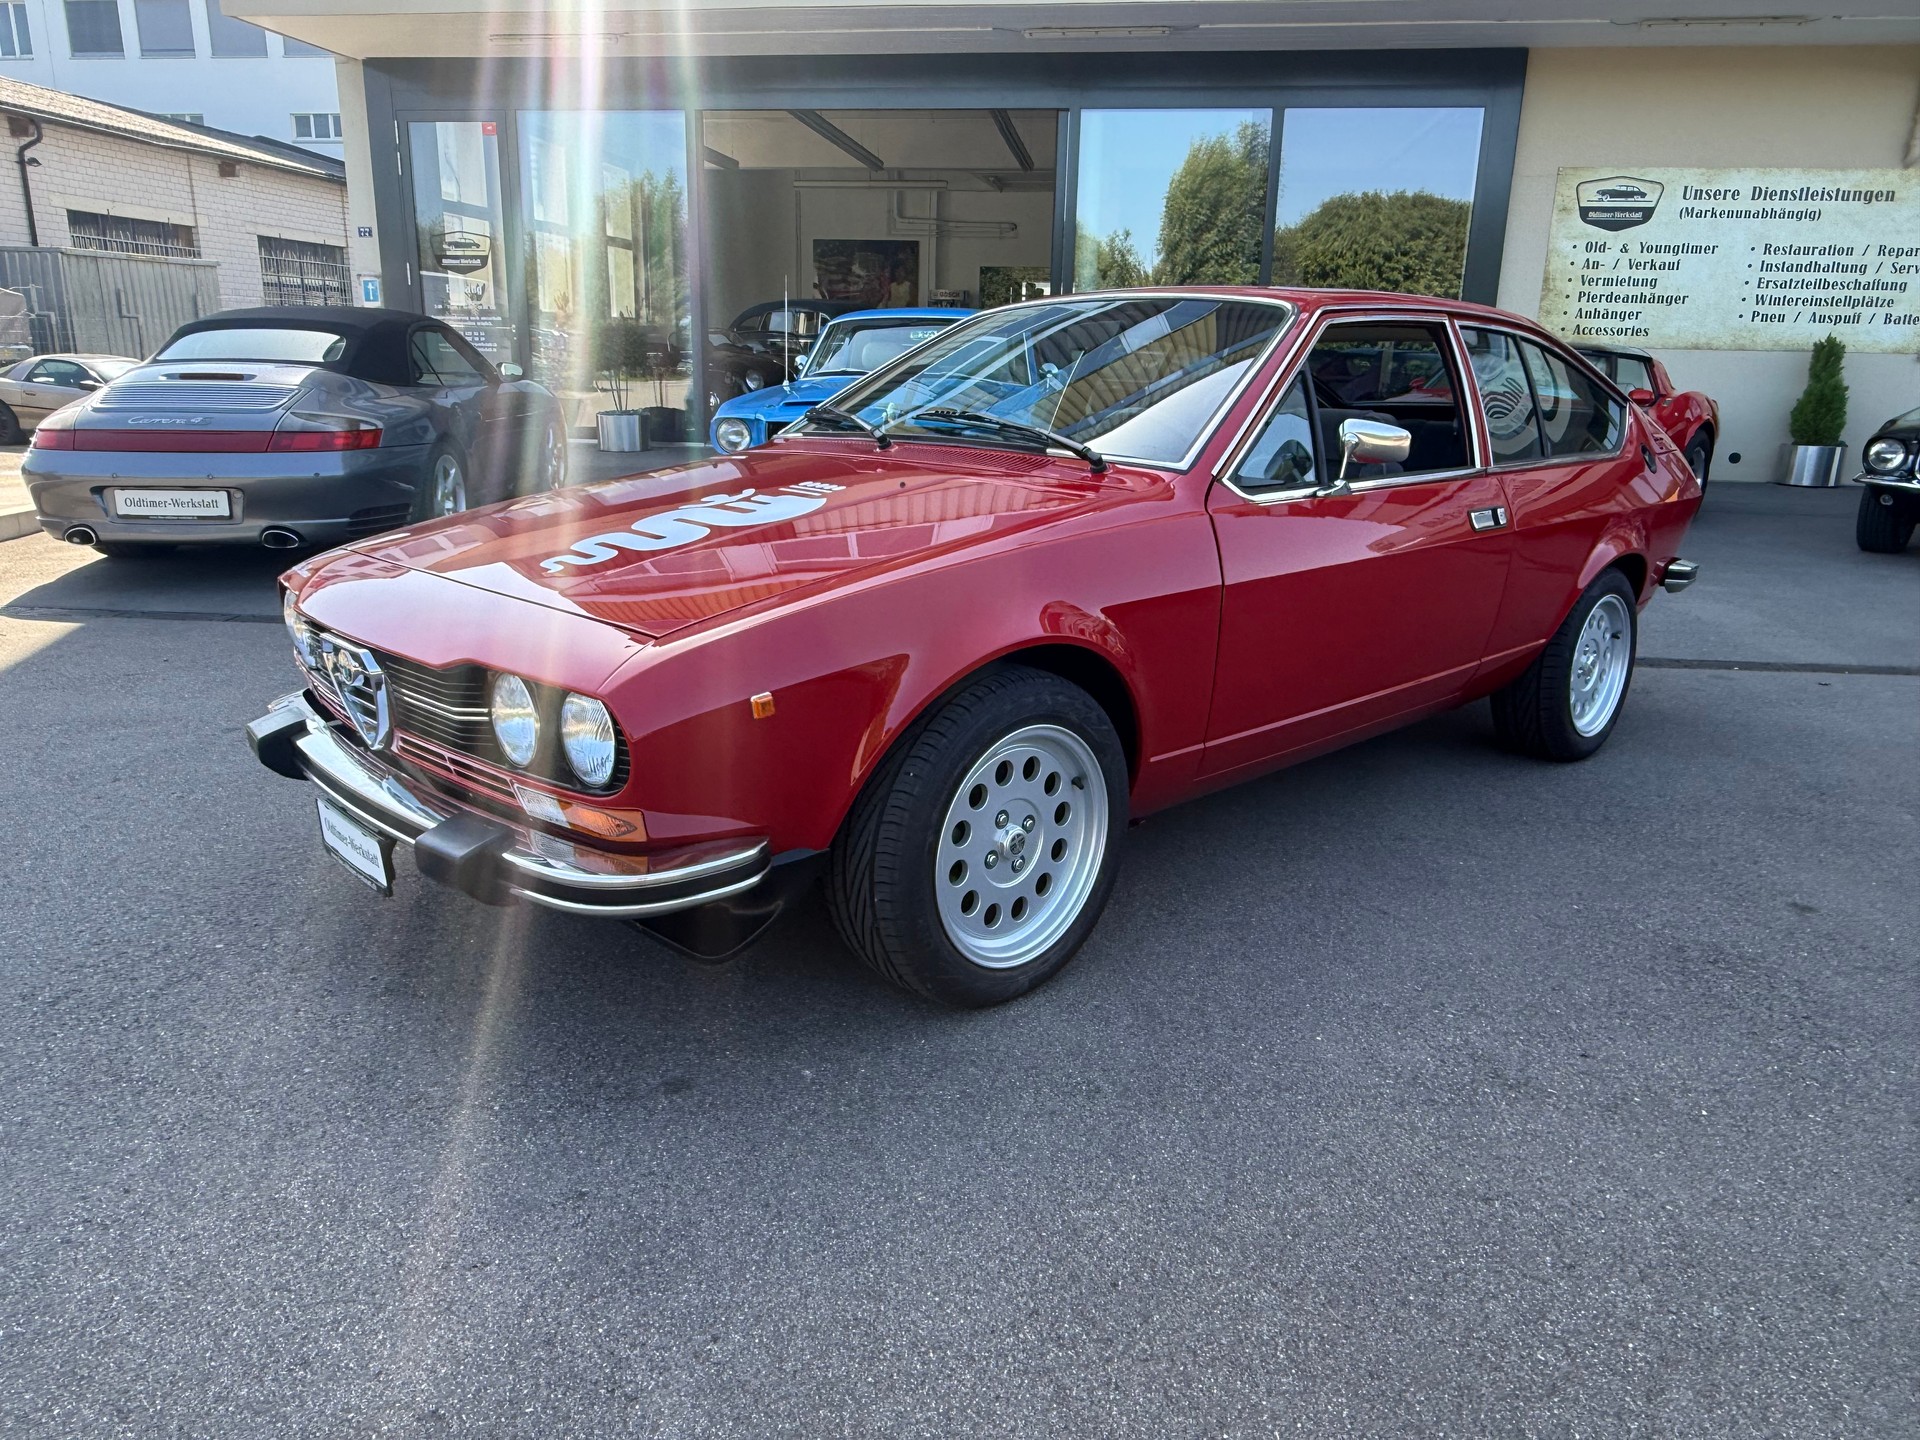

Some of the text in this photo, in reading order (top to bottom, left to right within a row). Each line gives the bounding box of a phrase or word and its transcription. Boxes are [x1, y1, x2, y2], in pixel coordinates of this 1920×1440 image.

[1682, 185, 1896, 205] Unsere Dienstleistungen
[1679, 206, 1822, 222] (Markenunabhängig)
[1585, 241, 1719, 257] Old- & Youngtimer
[1763, 243, 1855, 256] Restauration
[1582, 258, 1606, 270] An-
[1628, 259, 1682, 271] Verkauf
[1760, 260, 1868, 276] Instandhaltung
[1580, 275, 1658, 289] Vermietung
[1757, 277, 1908, 294] Ersatzteilbeschaffung
[1577, 291, 1689, 306] Pferdeanhänger
[1755, 294, 1894, 309] Wintereinstellplätze
[1575, 307, 1642, 322] Anhänger
[1751, 310, 1786, 323] Pneu
[1808, 311, 1862, 326] Auspuff
[1572, 324, 1650, 337] Accessories
[127, 416, 187, 424] Carrera
[124, 497, 219, 509] Oldtimer-Werkstatt
[324, 817, 380, 869] Oldtimer-Werkstatt
